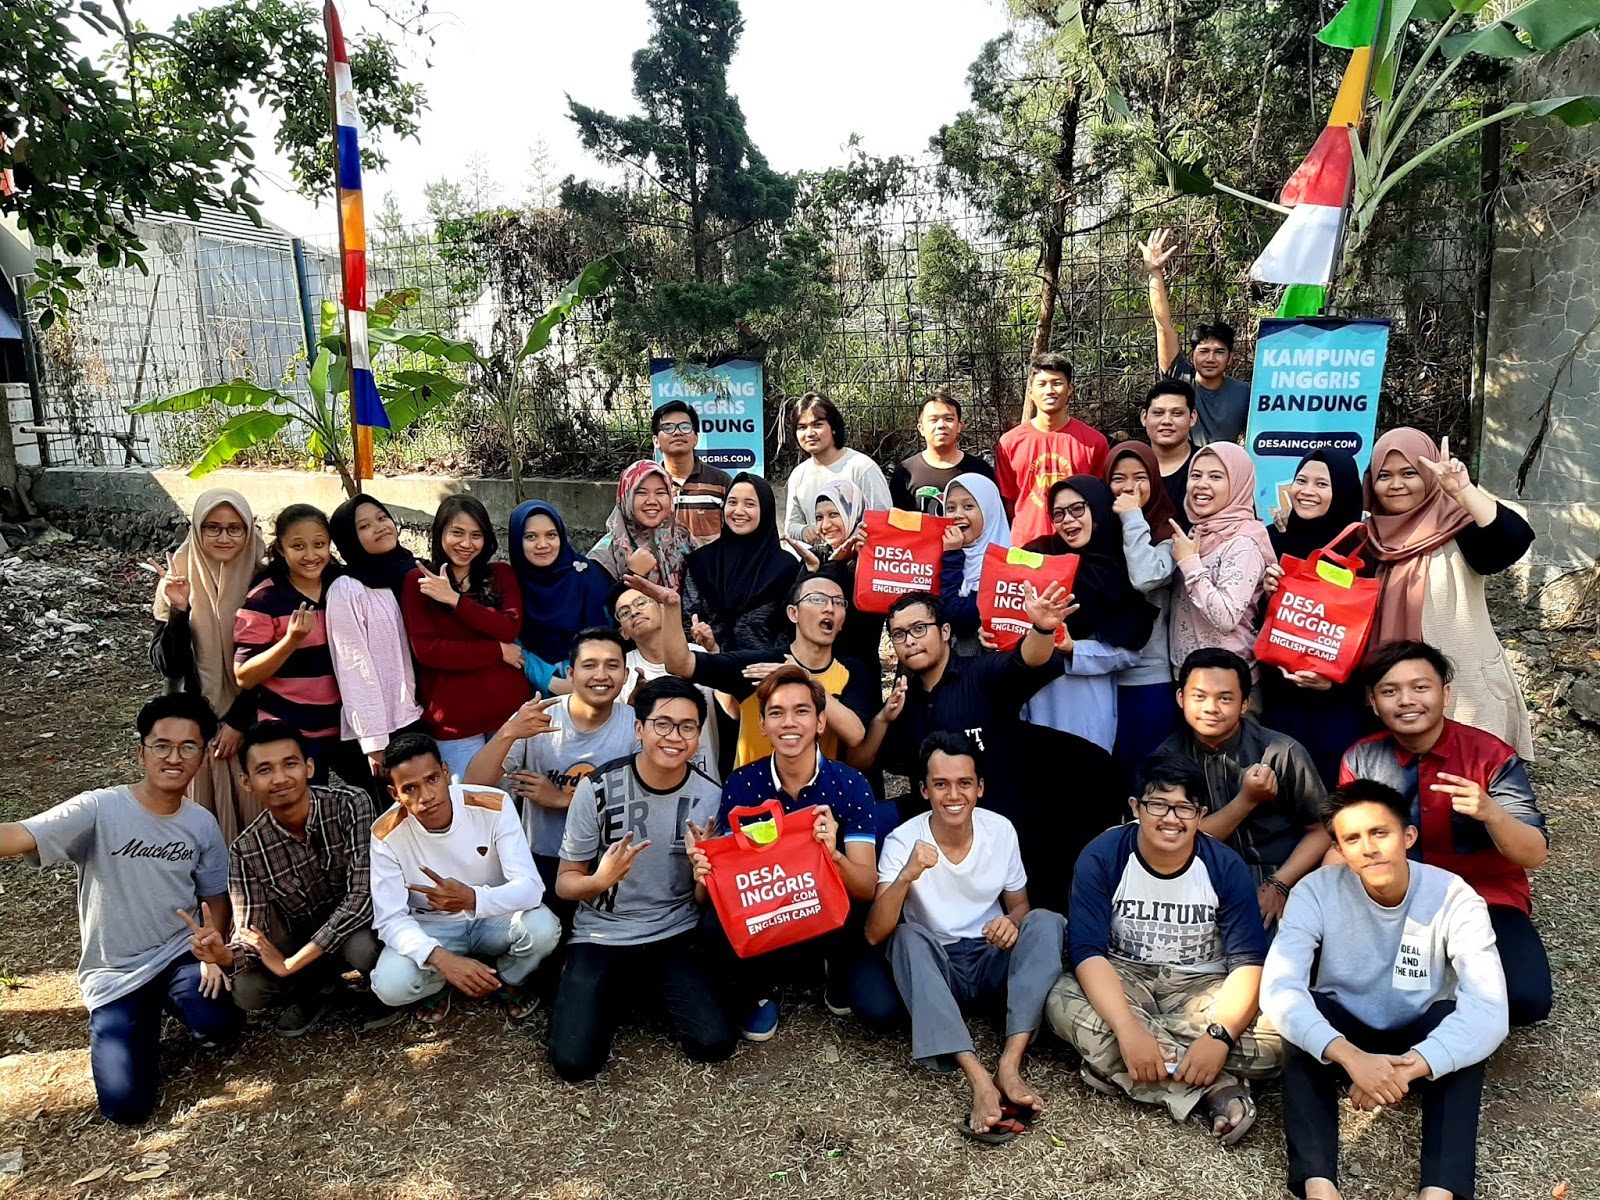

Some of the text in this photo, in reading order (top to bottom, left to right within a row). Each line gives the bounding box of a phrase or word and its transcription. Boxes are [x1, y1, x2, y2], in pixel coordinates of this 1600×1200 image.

[1262, 348, 1376, 367] KAMPUNG
[1271, 371, 1361, 389] INGGRIS
[658, 382, 755, 398] KANG
[694, 400, 745, 415] GGRIS
[1257, 394, 1368, 412] BANDUNG
[700, 419, 755, 433] DUNG
[699, 455, 751, 463] GGRIS.COM
[874, 545, 914, 561] DESA
[874, 559, 934, 577] INGGRIS
[910, 576, 932, 584] .COM
[872, 584, 906, 595] ENGLISH
[1281, 592, 1325, 617] DESA
[991, 623, 1026, 635] ENGLISH
[1276, 606, 1347, 640] INGGRIS
[1269, 634, 1337, 662] ENGLISH CAMP
[1314, 635, 1341, 649] .COM
[547, 769, 582, 791] Hard
[111, 838, 196, 861] MatchBox
[735, 863, 787, 890] DESA
[740, 872, 816, 908] INGGRIS
[791, 889, 818, 903] .COM
[748, 904, 822, 935] ENGLISH CAMP
[1402, 956, 1419, 967] AND
[1395, 966, 1428, 978] THE REAL
